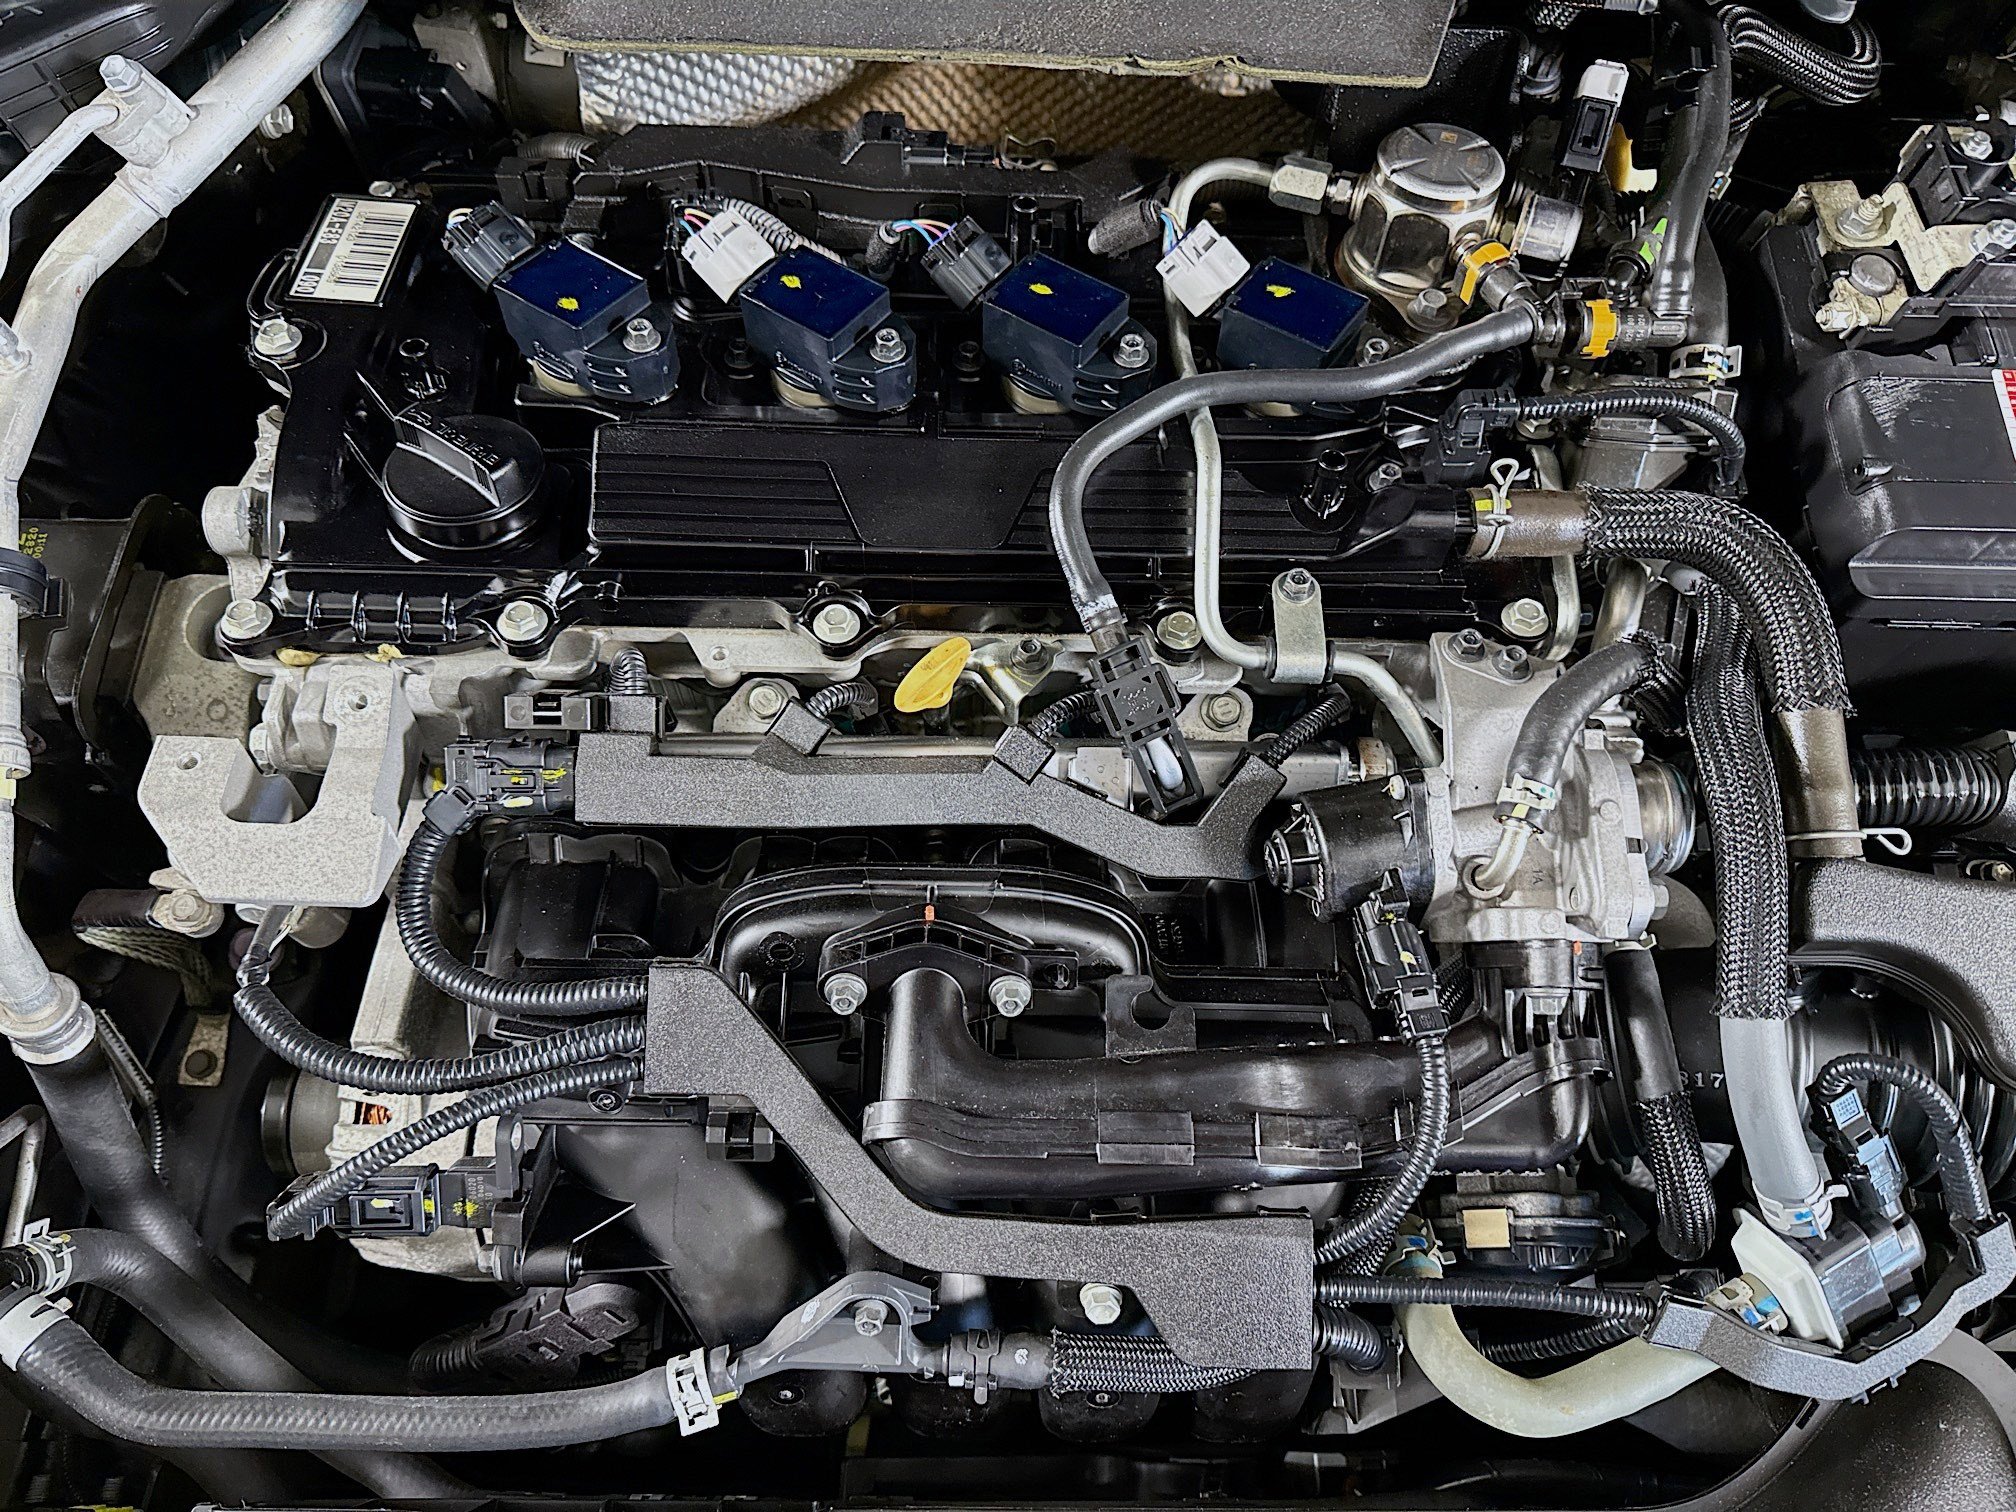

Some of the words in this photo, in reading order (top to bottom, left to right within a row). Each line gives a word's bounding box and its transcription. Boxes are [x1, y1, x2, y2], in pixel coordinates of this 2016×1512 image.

[319, 199, 358, 245] M20A-E83
[295, 274, 321, 295] 090
[23, 527, 39, 555] 2820
